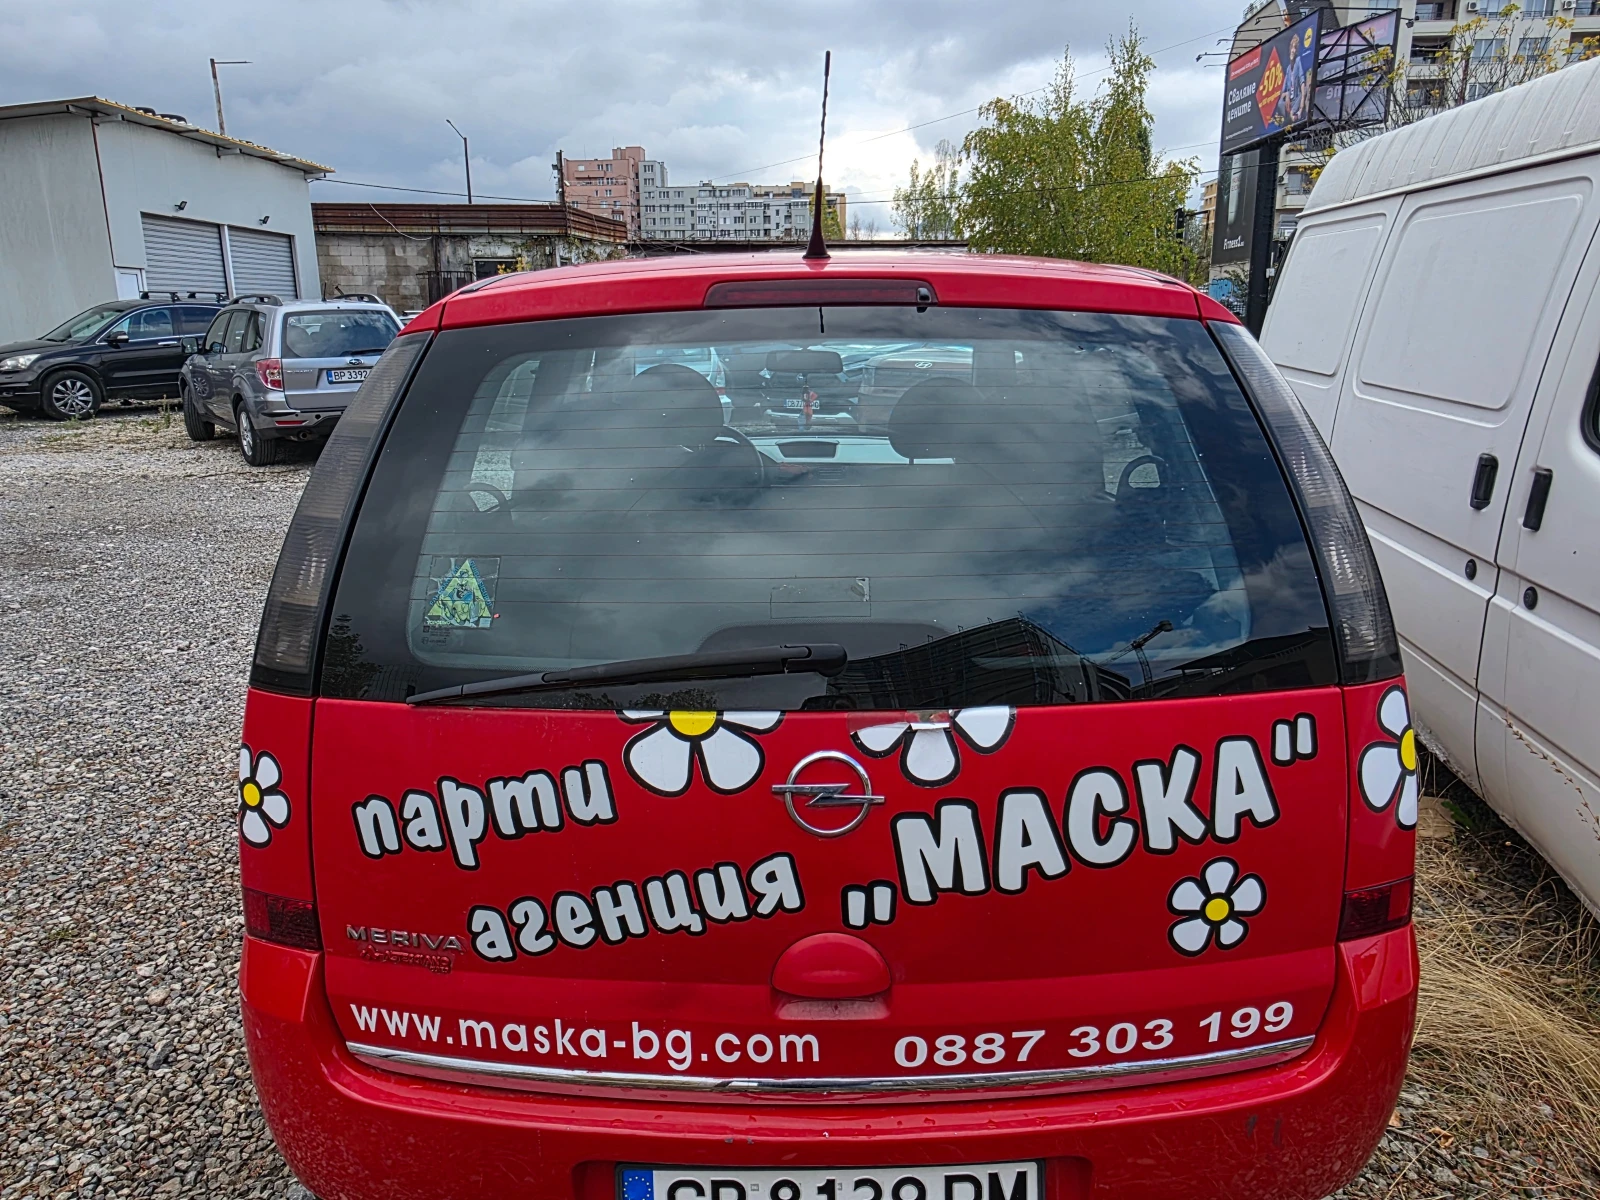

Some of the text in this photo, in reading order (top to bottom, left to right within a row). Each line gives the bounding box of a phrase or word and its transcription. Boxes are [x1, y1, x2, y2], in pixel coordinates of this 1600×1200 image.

[1228, 82, 1256, 105] Сваляме
[1260, 63, 1283, 95] -50%
[1227, 101, 1251, 123] цените
[353, 760, 618, 870] парти
[468, 853, 805, 962] агенция
[346, 924, 464, 951] MERIVA
[350, 1004, 820, 1070] www.maska-bg.com
[894, 1001, 1294, 1068] 0887 303 199
